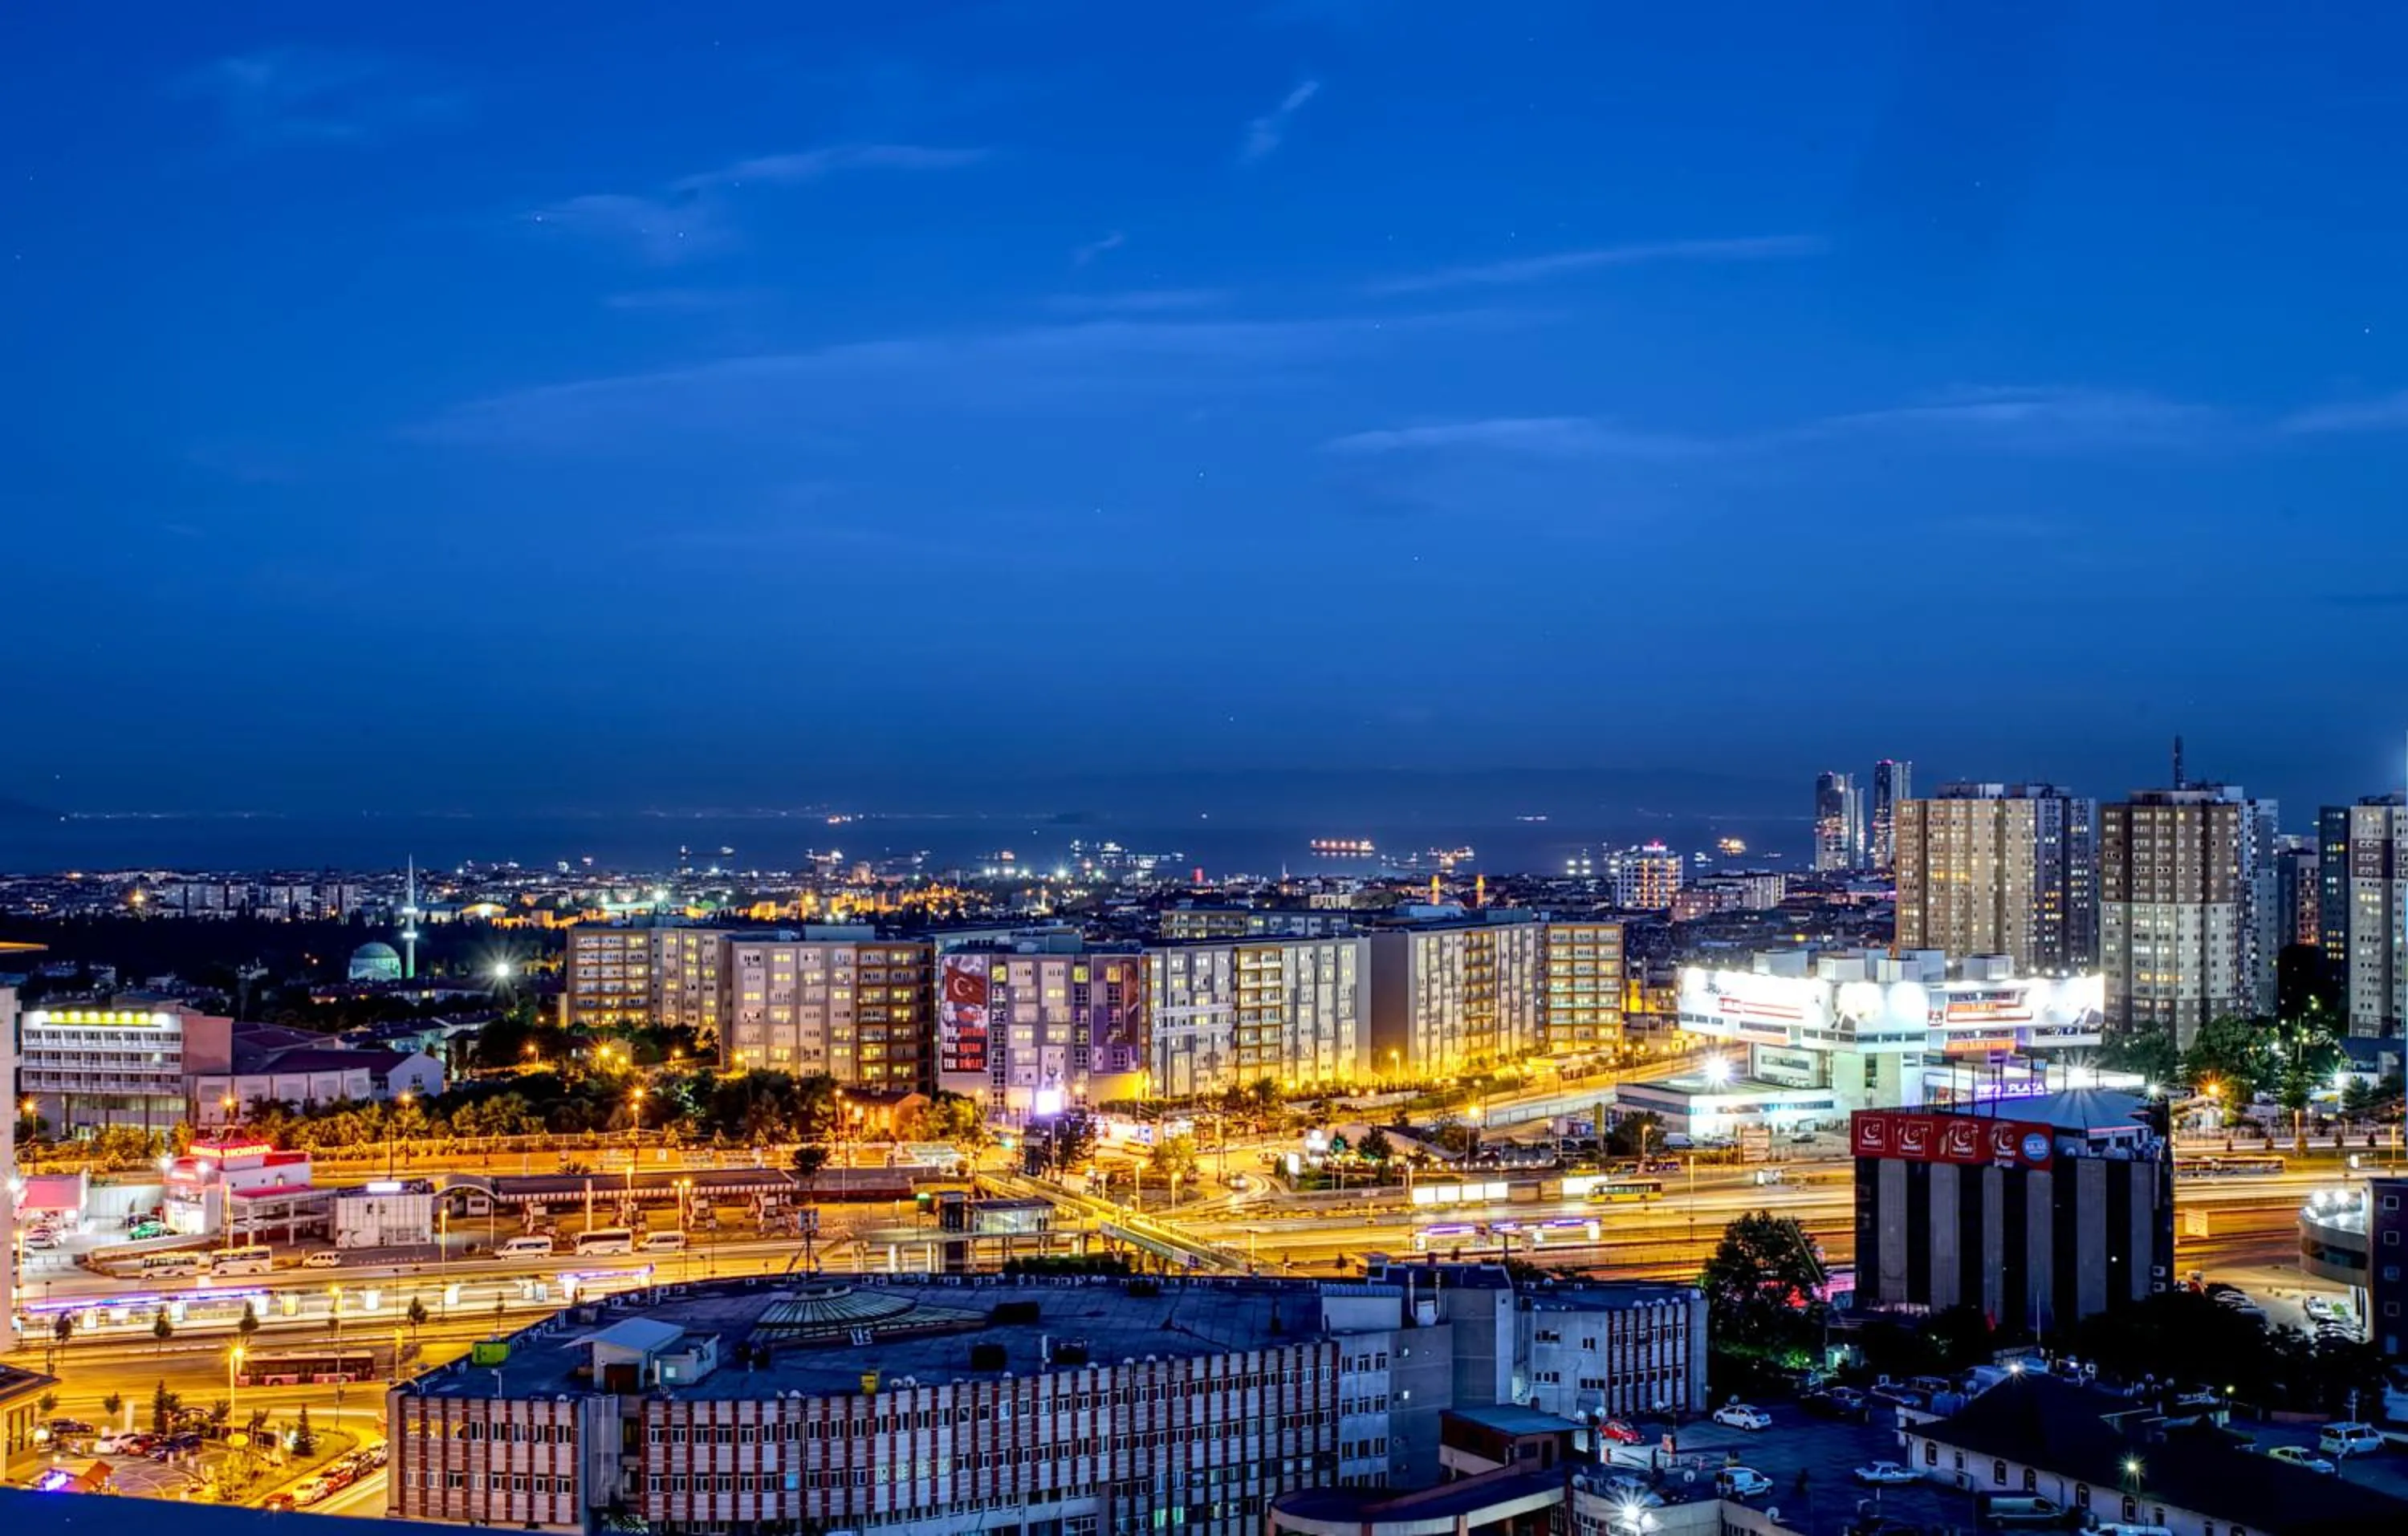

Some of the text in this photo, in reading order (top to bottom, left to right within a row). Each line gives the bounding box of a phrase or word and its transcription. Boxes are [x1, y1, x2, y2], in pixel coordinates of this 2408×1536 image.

[945, 1043, 957, 1053] TEK
[944, 1059, 957, 1069] TEK
[223, 1144, 272, 1158] HONDA
